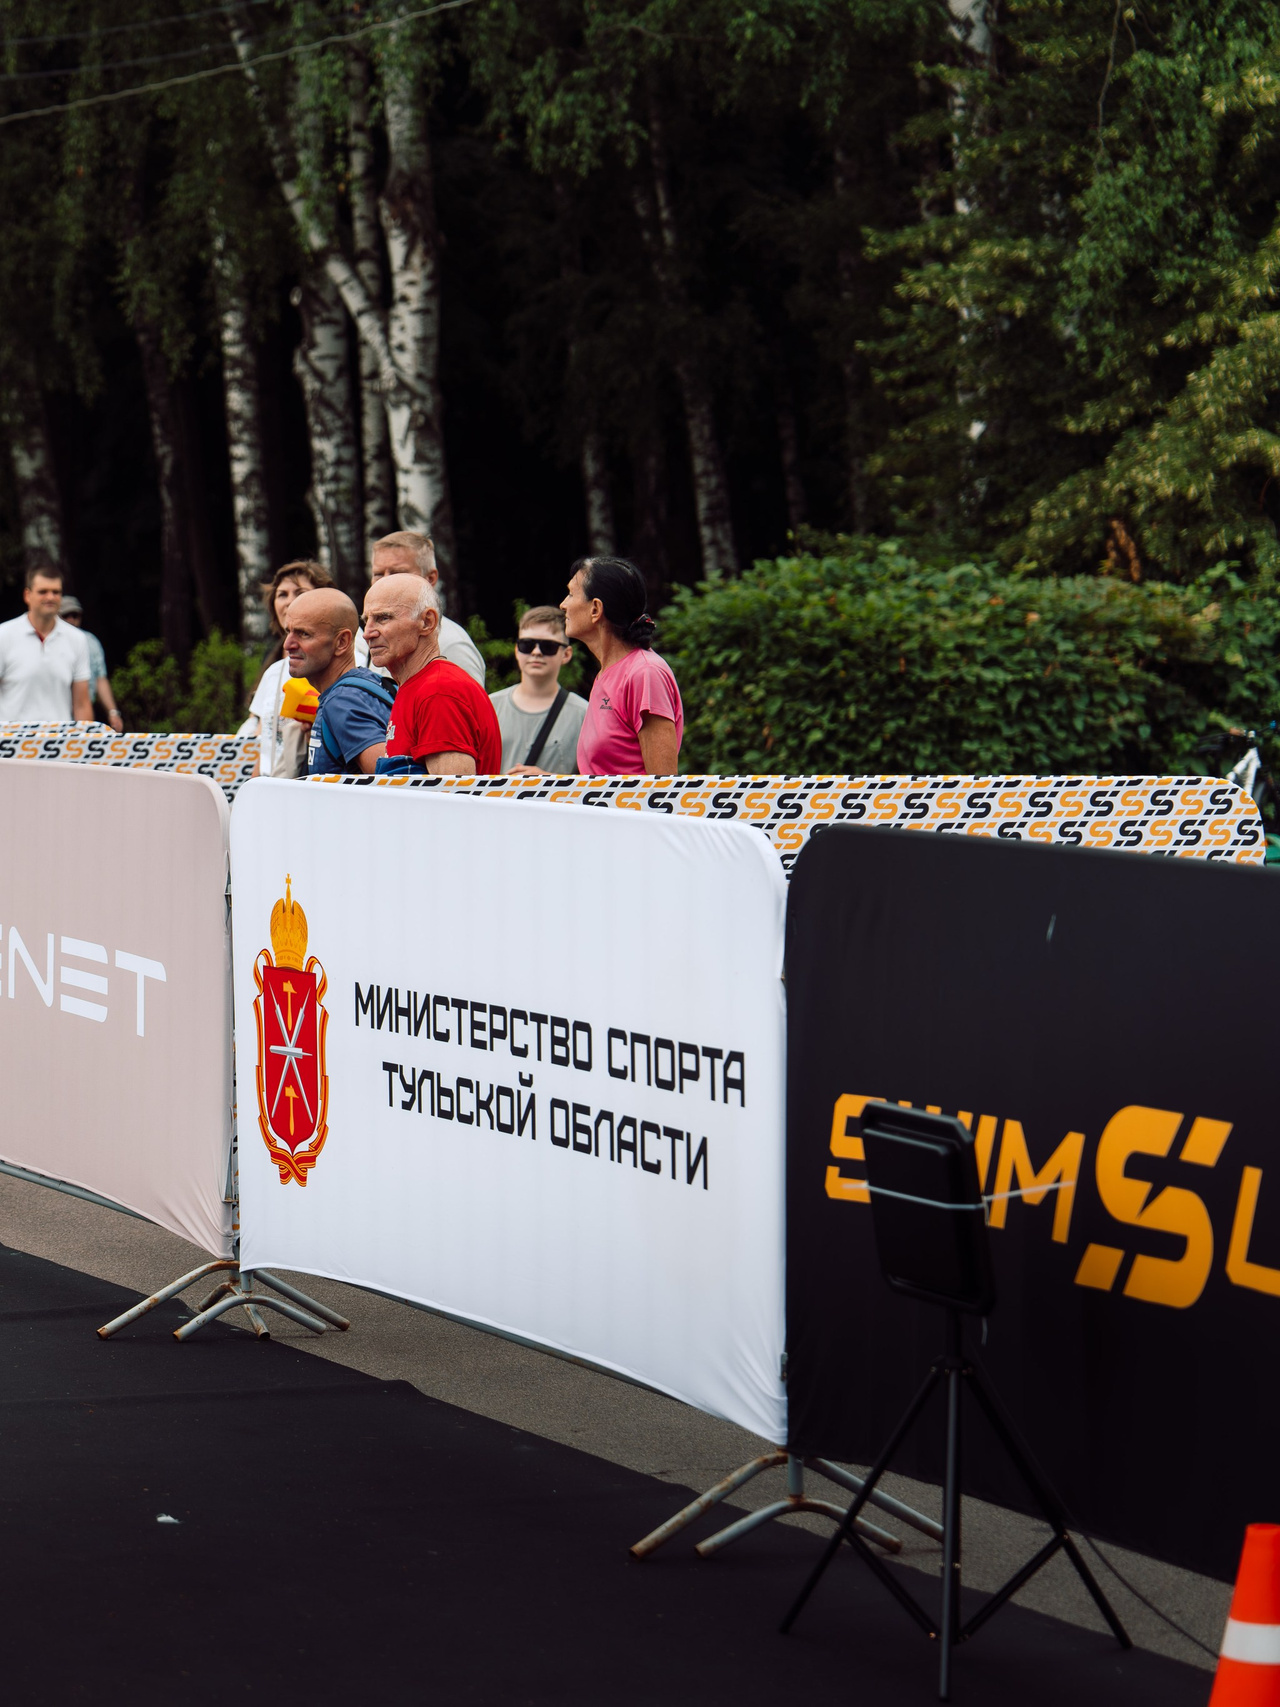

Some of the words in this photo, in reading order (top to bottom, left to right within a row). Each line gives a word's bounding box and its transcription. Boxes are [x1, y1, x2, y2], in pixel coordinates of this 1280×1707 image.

[354, 981, 593, 1073] МИНИСТЕРСТВО
[607, 1028, 746, 1108] СПОРТА
[381, 1060, 537, 1141] ТУЛЬСКОЙ
[549, 1097, 709, 1191] ОБЛАСТИ
